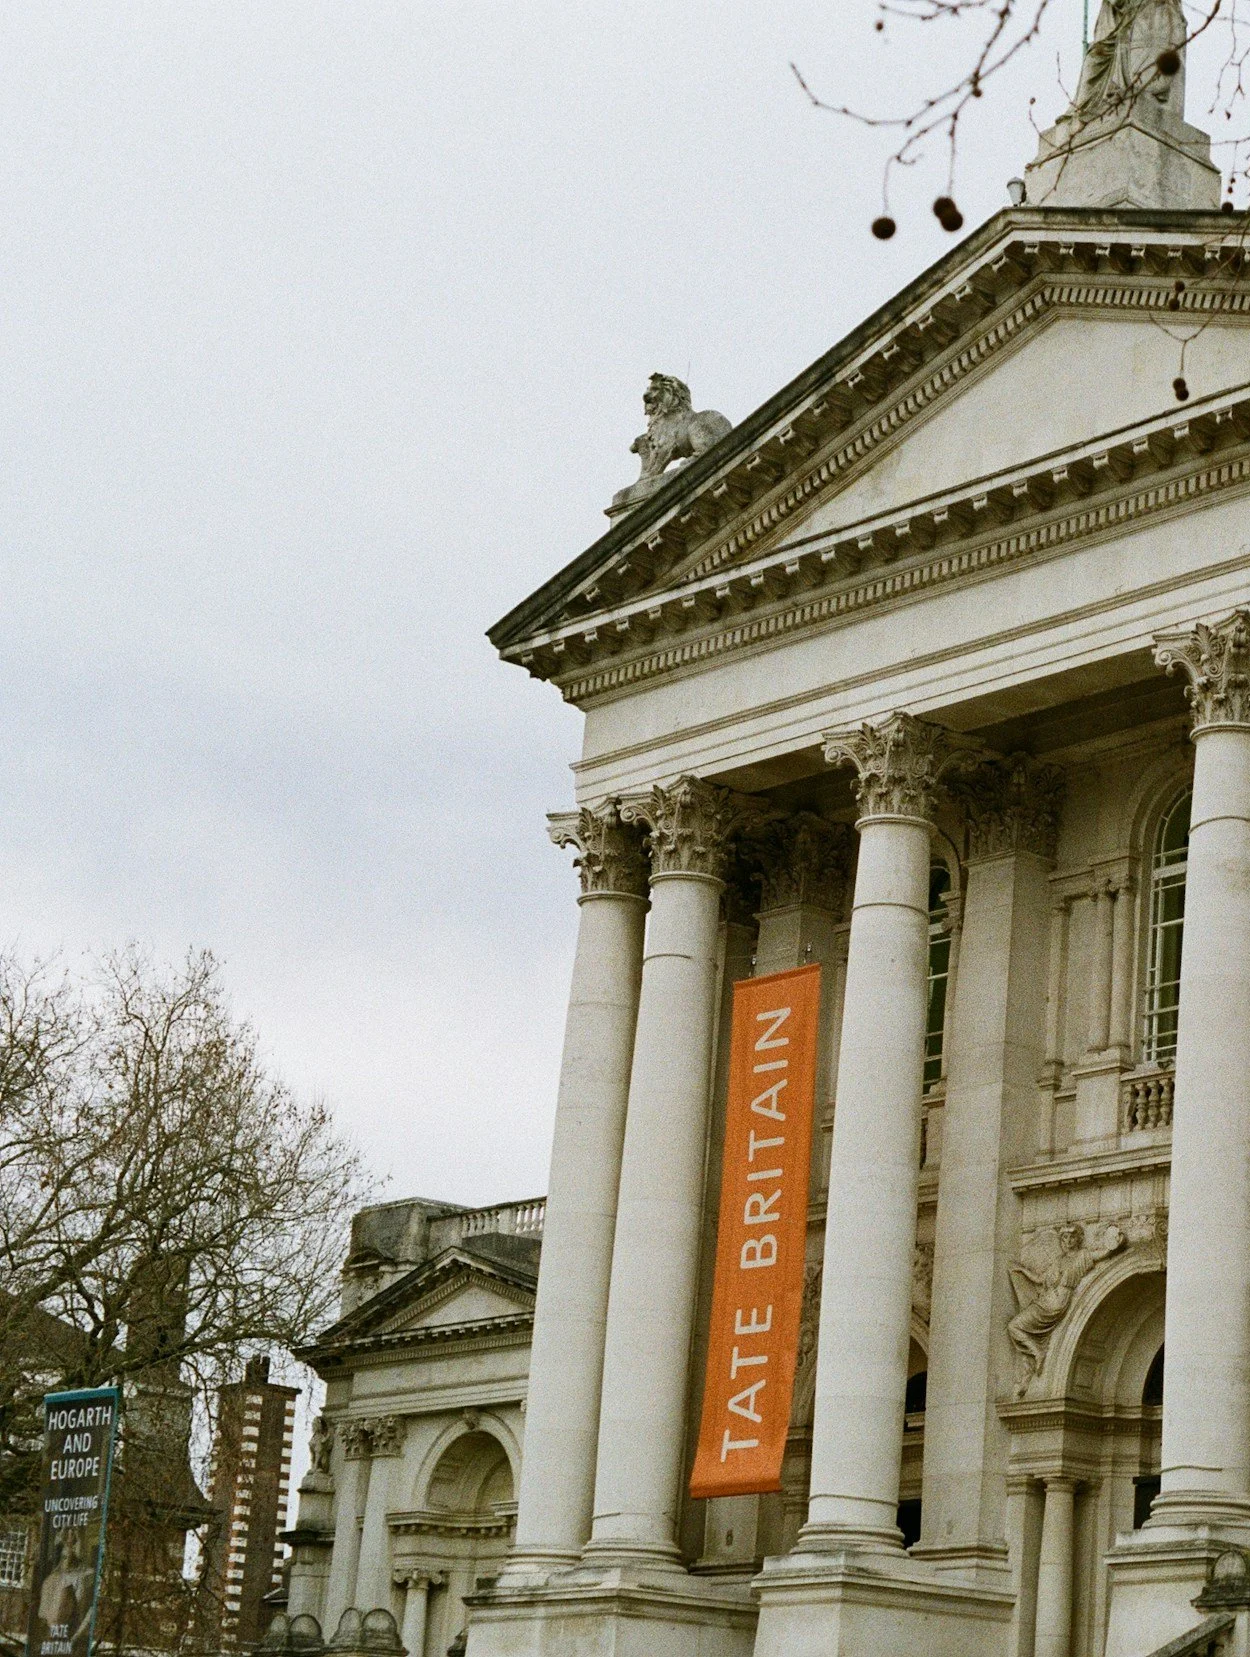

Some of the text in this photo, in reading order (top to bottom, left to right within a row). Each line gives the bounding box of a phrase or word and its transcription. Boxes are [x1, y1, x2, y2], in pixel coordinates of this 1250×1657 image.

[720, 1006, 792, 1463] TATE BRITAIN
[48, 1406, 111, 1430] HOGARTH
[62, 1432, 92, 1454] AND
[50, 1456, 100, 1480] EUROPE
[44, 1496, 99, 1513] UNCOVERING
[52, 1513, 88, 1528] CITY LIFE
[49, 1623, 69, 1639] TATE
[40, 1640, 73, 1656] BRITAIN
